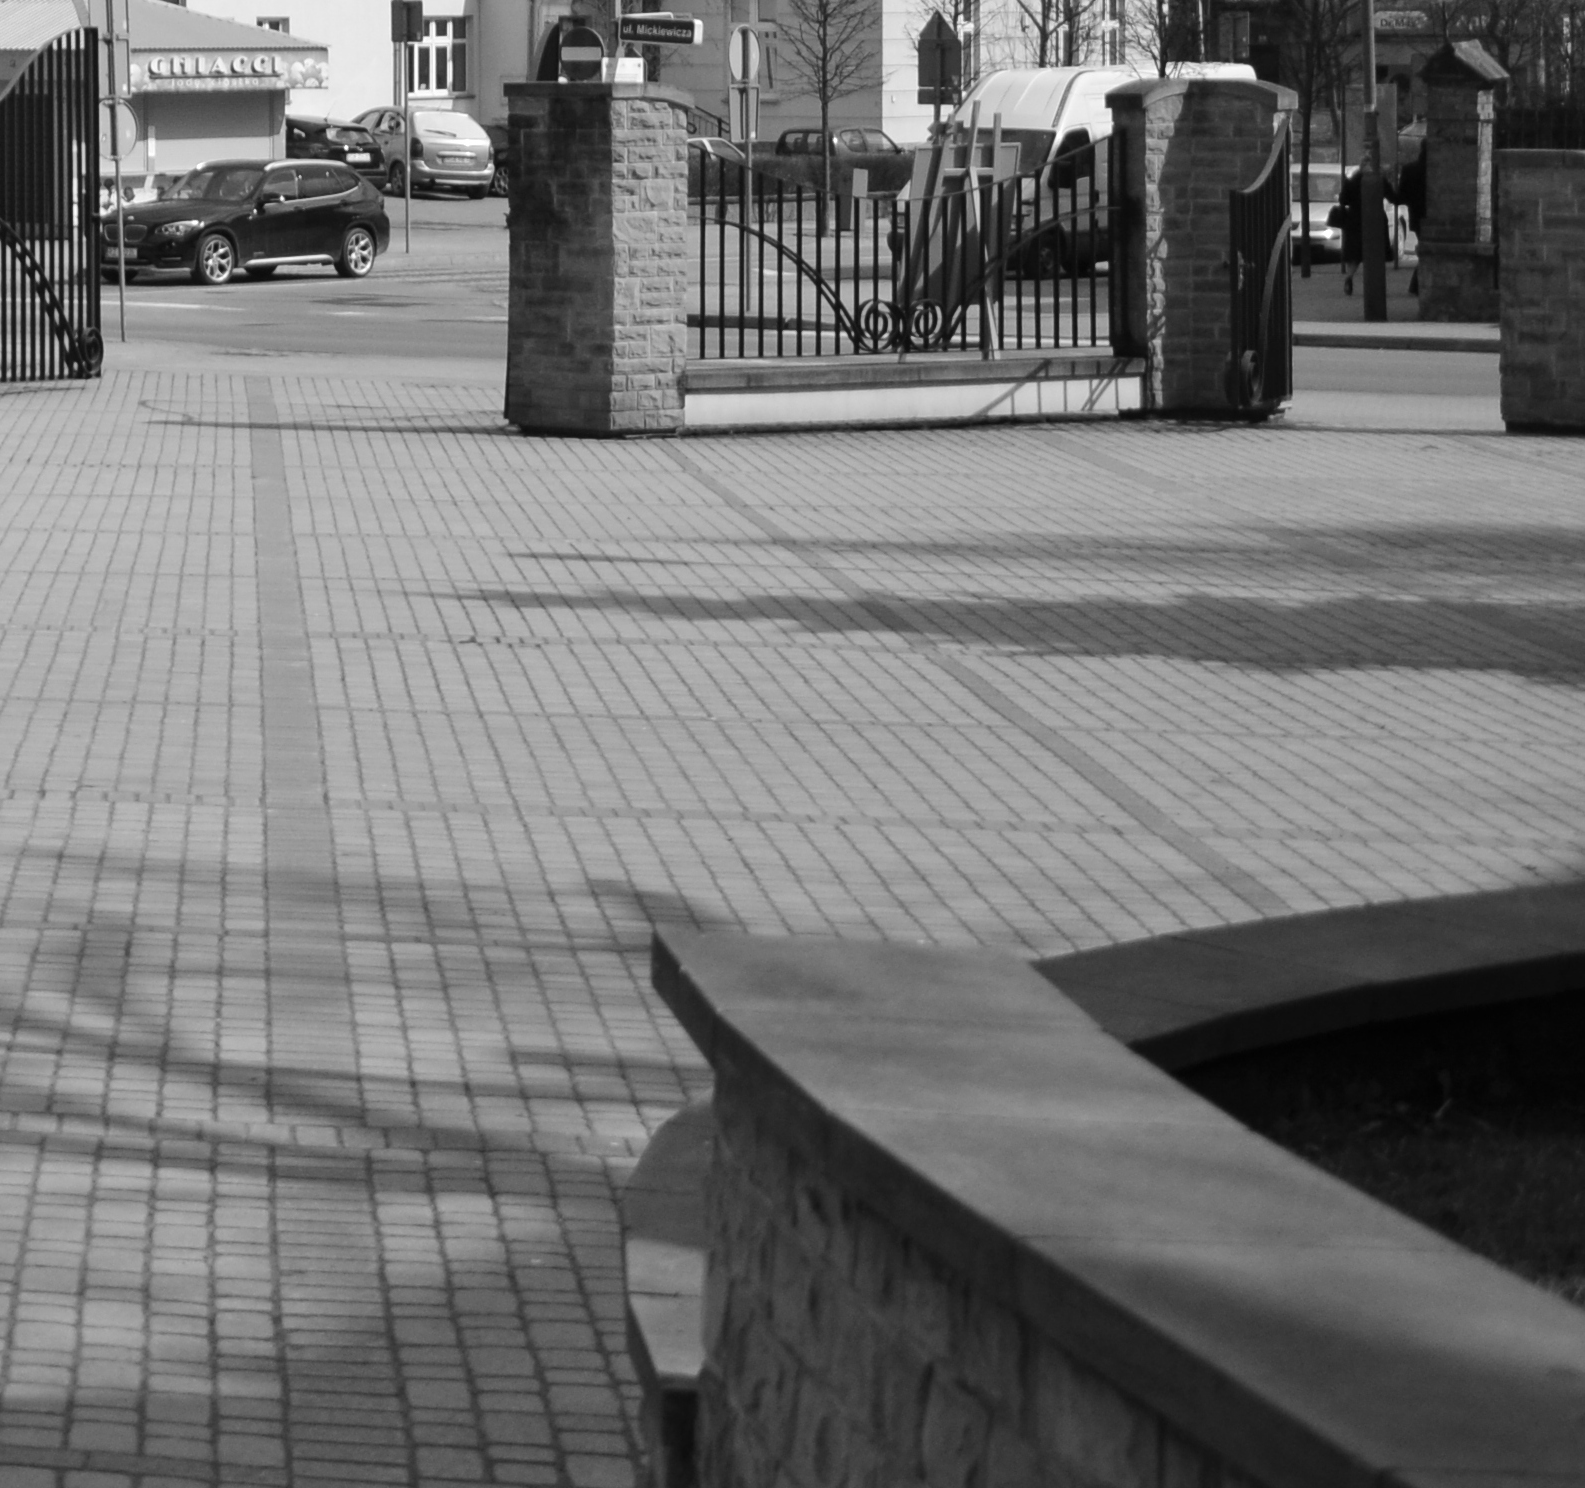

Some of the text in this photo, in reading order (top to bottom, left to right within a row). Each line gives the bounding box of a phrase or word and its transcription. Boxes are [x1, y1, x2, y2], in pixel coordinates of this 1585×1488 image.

[622, 24, 692, 38] ul. Mickiewicza
[148, 55, 282, 76] GHIACCI
